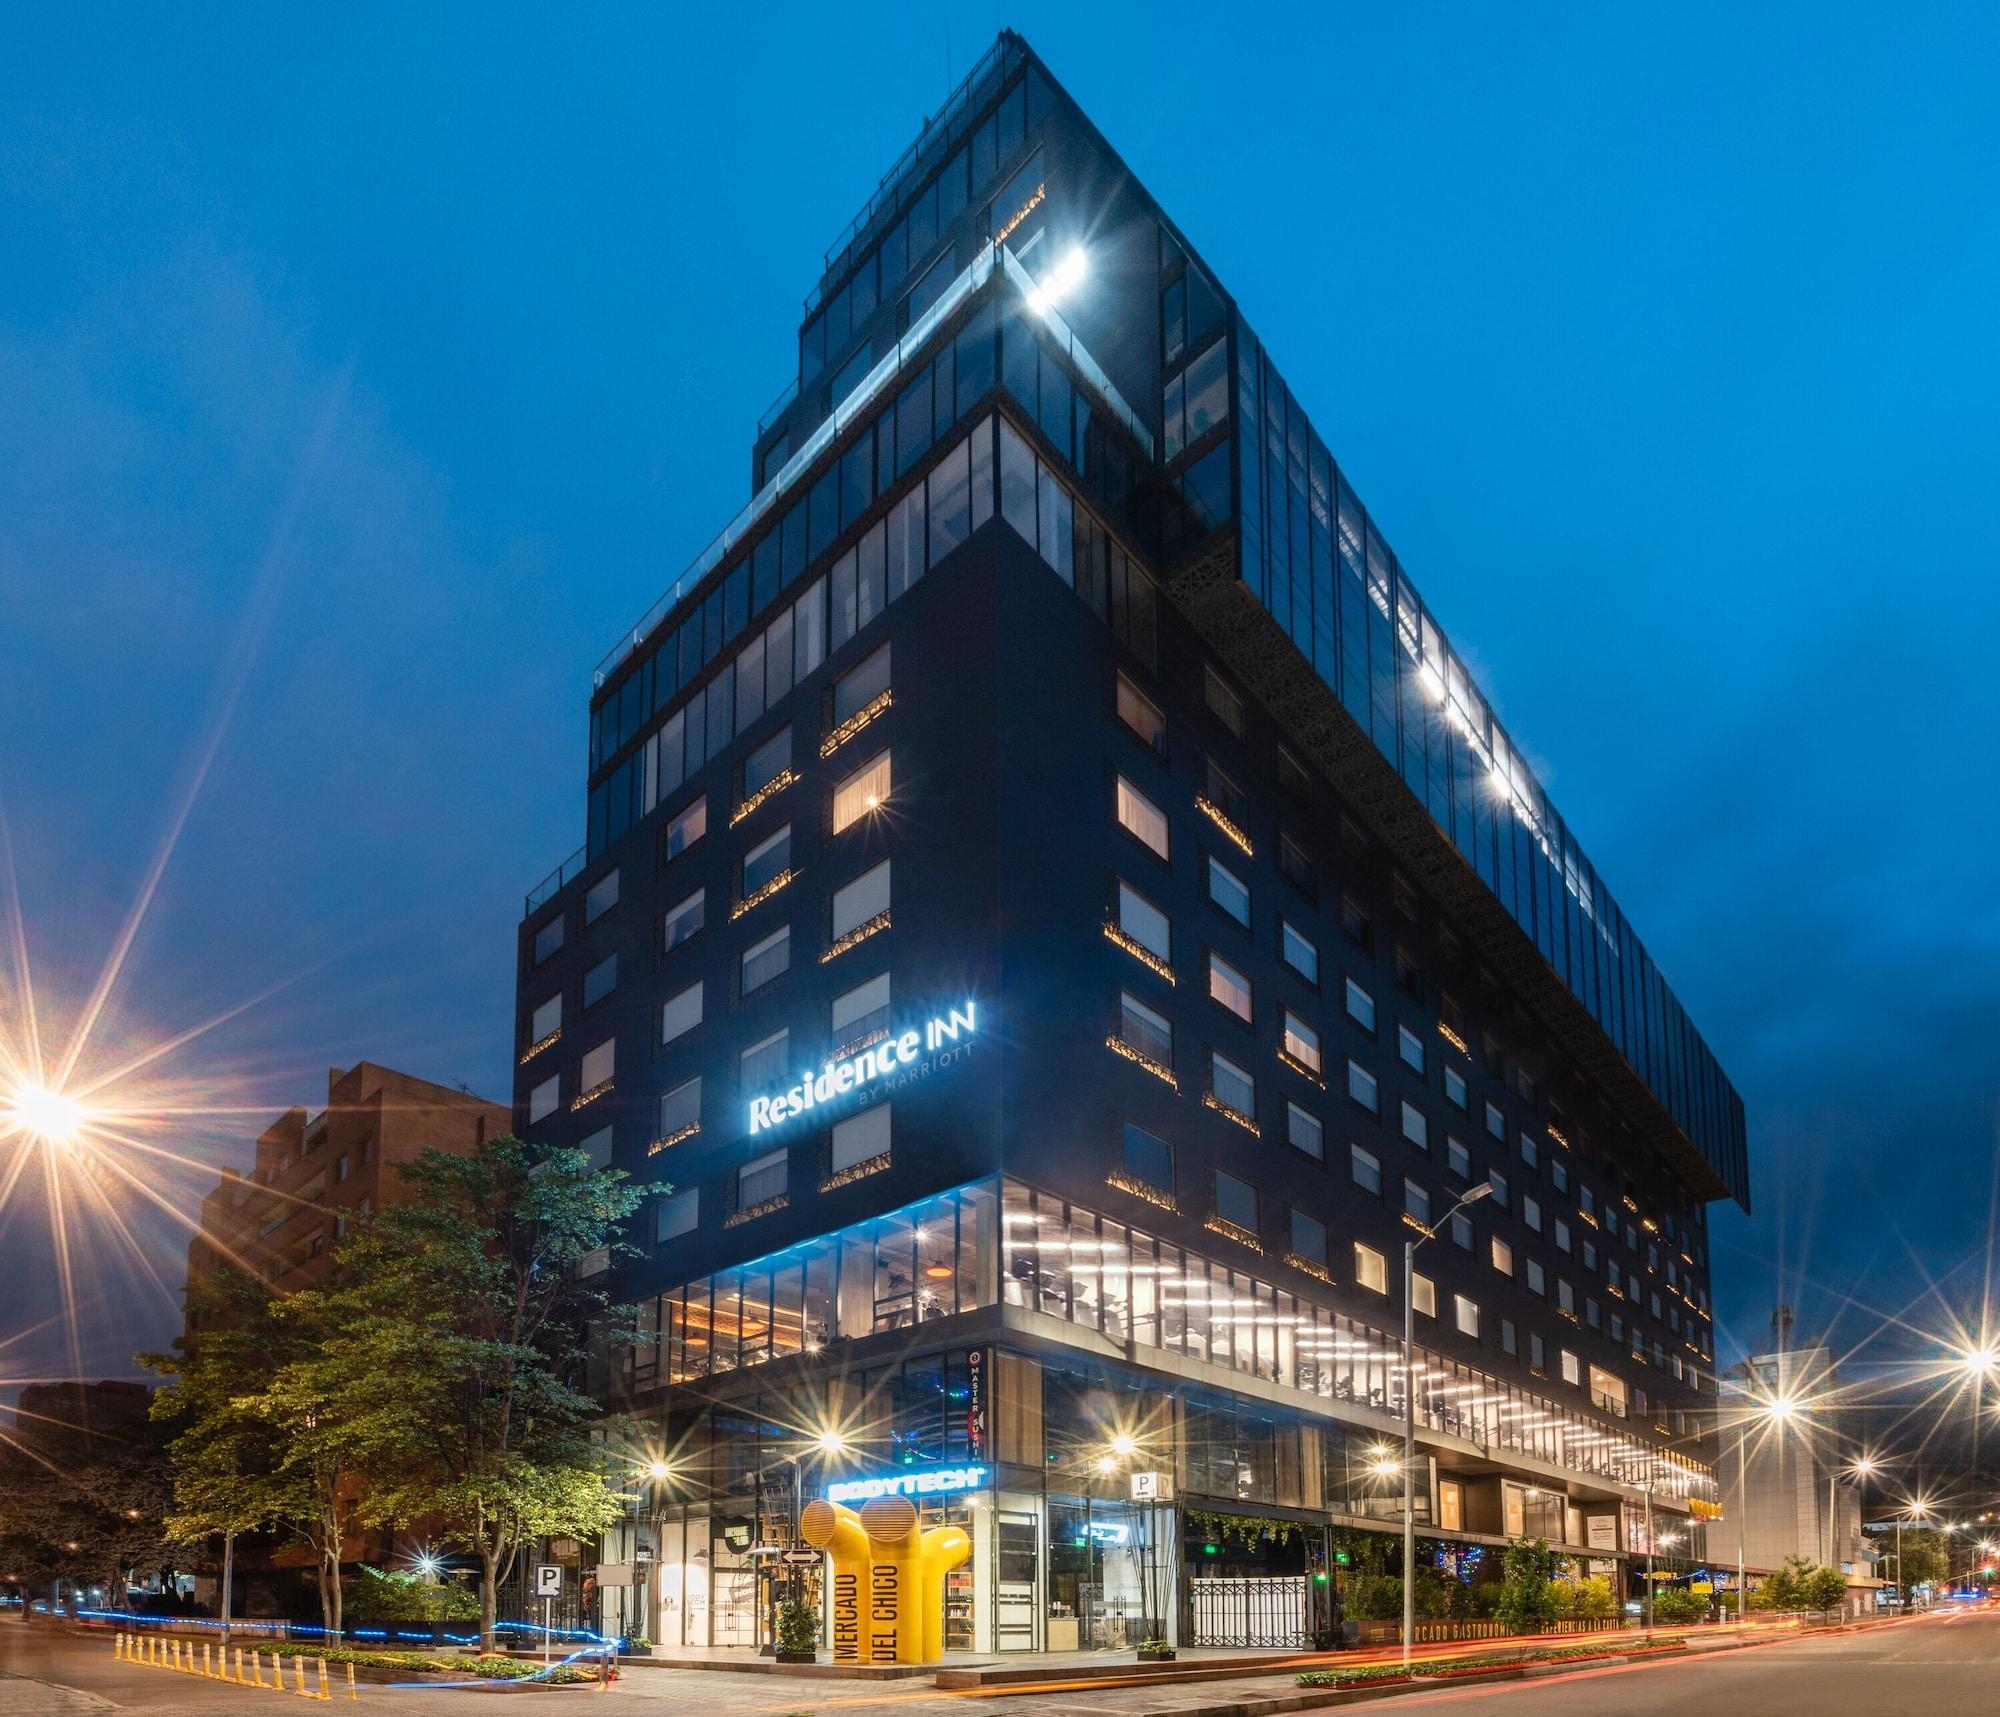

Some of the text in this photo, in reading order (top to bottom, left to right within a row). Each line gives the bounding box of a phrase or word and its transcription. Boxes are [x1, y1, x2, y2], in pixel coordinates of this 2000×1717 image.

[750, 1001, 975, 1135] Residence INN
[859, 1041, 974, 1105] BY MARRIOTT
[971, 1367, 980, 1412] MASTER
[972, 1418, 980, 1456] SUSHI
[1139, 1476, 1149, 1490] P
[1160, 1477, 1169, 1495] P
[542, 1569, 557, 1586] P
[835, 1574, 858, 1660] MERCADO
[872, 1565, 898, 1661] DEL CHICO
[1399, 1624, 1448, 1643] MRCADO
